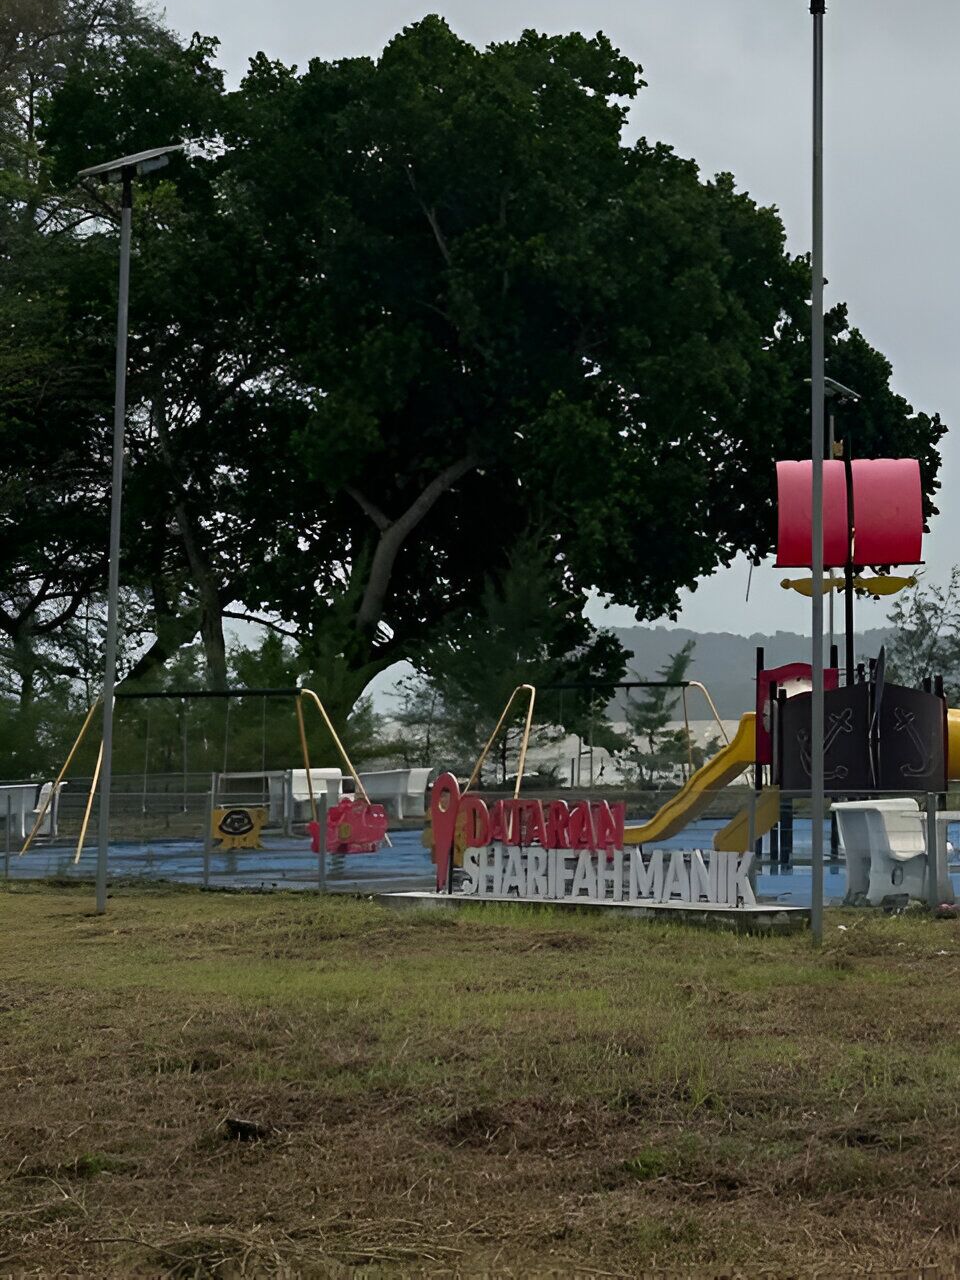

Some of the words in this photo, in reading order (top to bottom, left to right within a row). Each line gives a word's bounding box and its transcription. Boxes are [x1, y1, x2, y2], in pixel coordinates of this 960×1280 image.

[462, 797, 626, 850] DATARAN
[462, 845, 624, 901] SHARIFAH
[628, 846, 757, 908] MANIK
